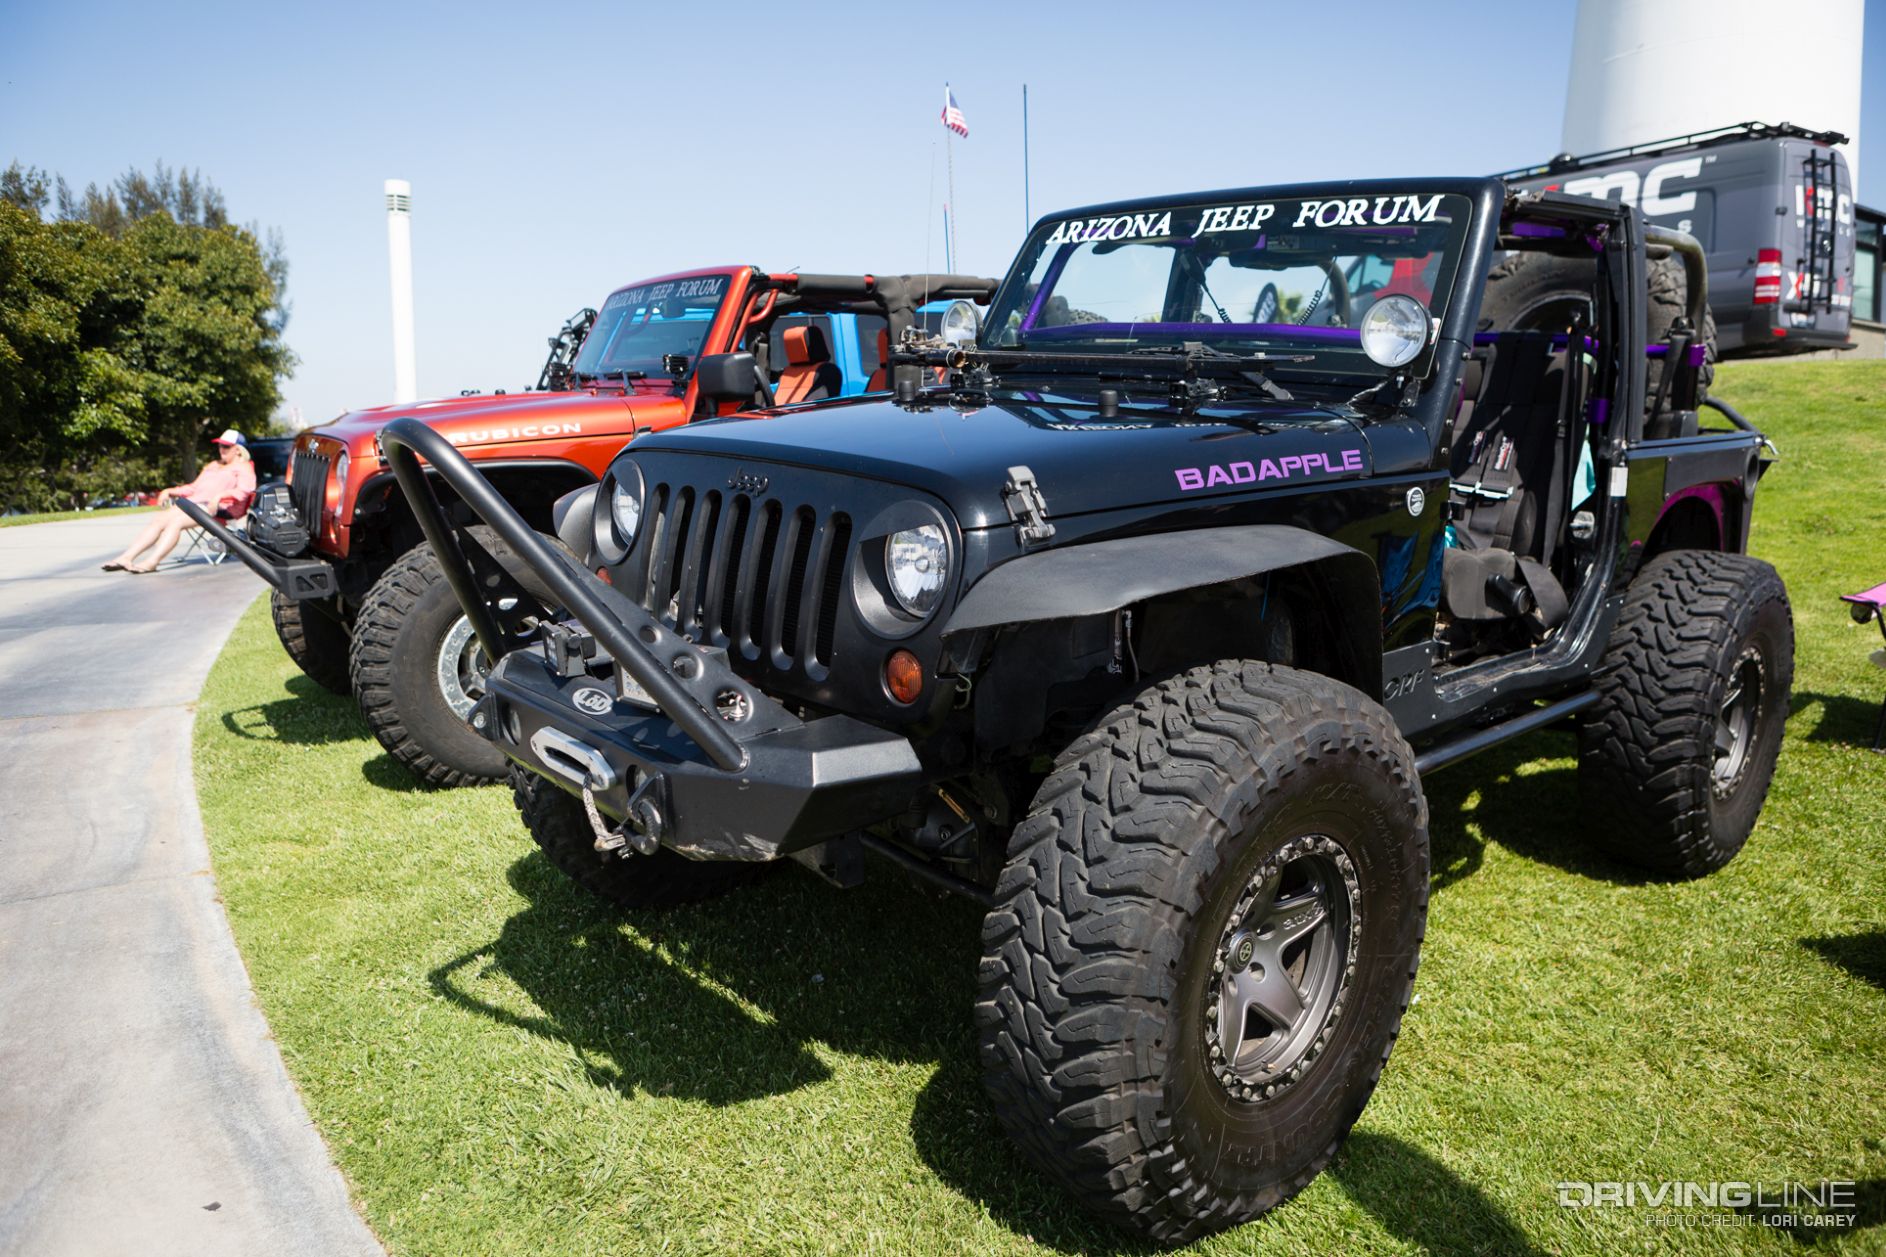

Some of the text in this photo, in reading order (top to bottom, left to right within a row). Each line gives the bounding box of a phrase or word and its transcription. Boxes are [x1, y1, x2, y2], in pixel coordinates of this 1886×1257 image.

[1046, 194, 1445, 245] ARIZONA JEEP FORUM
[647, 283, 675, 302] JEEP
[676, 278, 724, 298] FORUM
[447, 422, 581, 444] RUBICON
[1174, 449, 1364, 491] BADAPPLE
